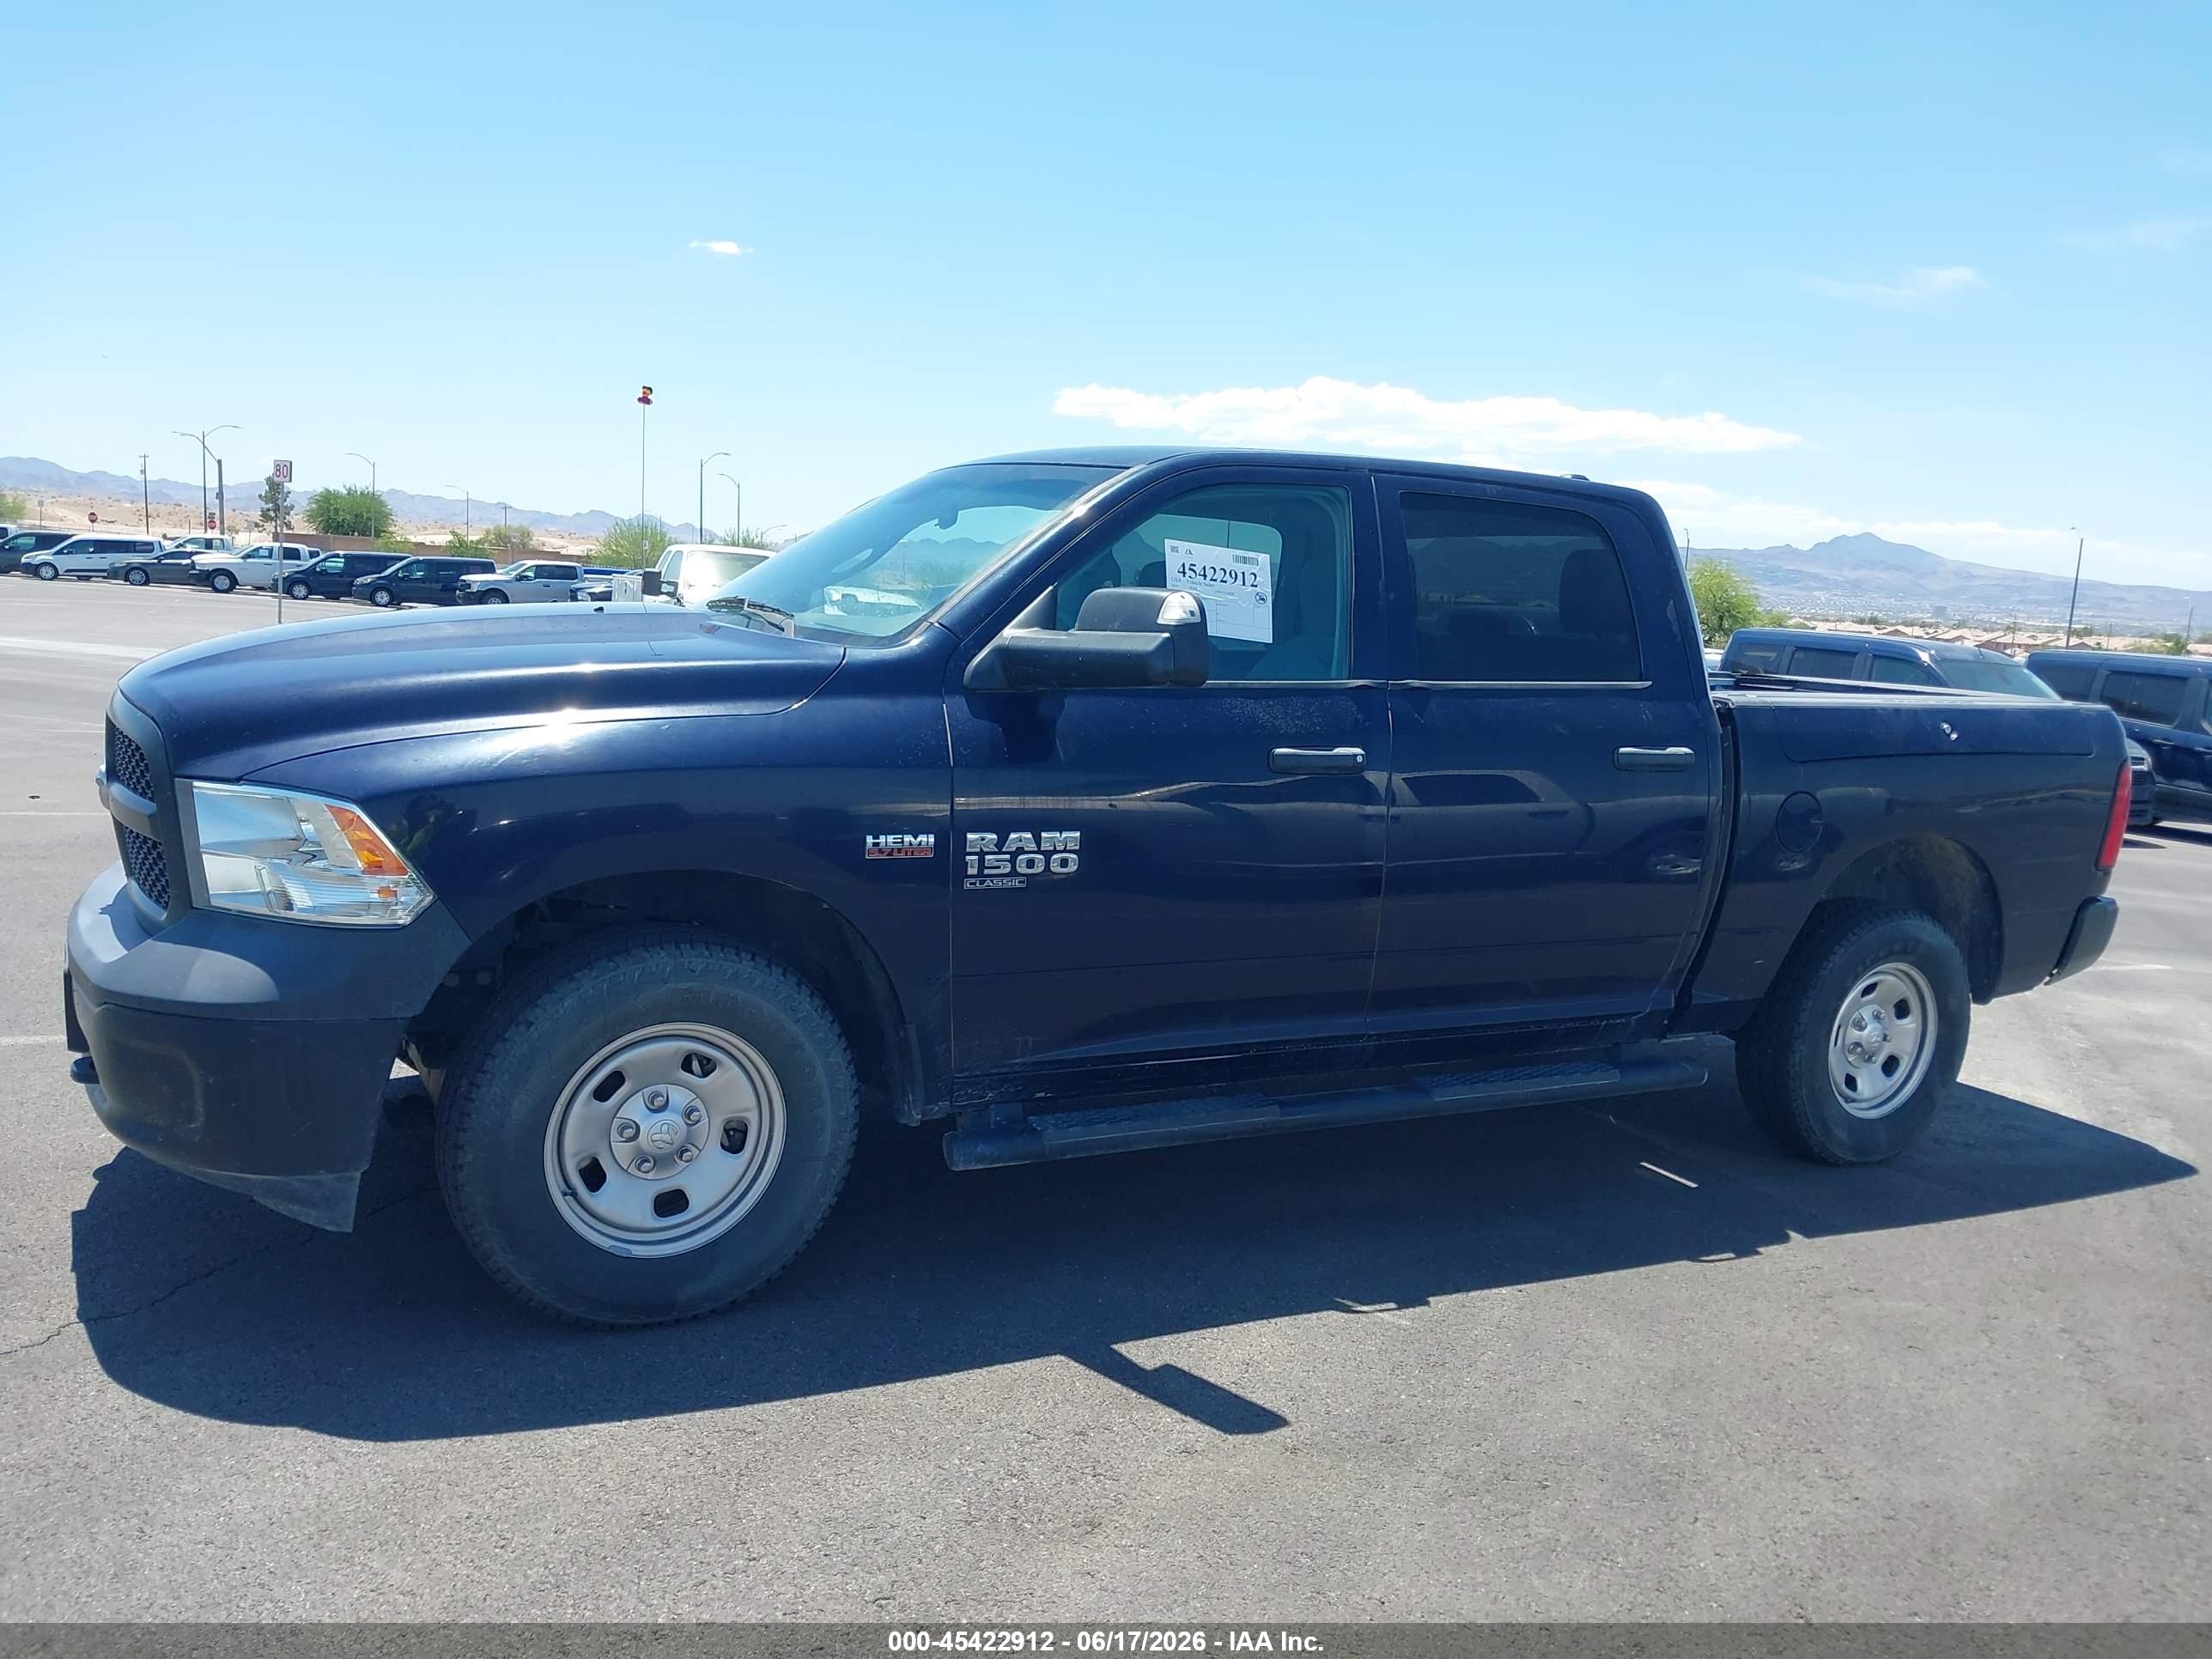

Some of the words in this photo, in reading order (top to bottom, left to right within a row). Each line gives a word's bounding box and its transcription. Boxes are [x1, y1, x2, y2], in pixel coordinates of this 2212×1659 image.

[275, 464, 289, 478] 80
[1177, 562, 1258, 587] 45422912
[866, 834, 935, 848] HEMI
[966, 831, 1080, 852] RAM
[868, 848, 891, 857] 5.7
[892, 848, 932, 856] LITER
[965, 853, 1079, 875] 1500
[966, 878, 1025, 888] CLASSIC
